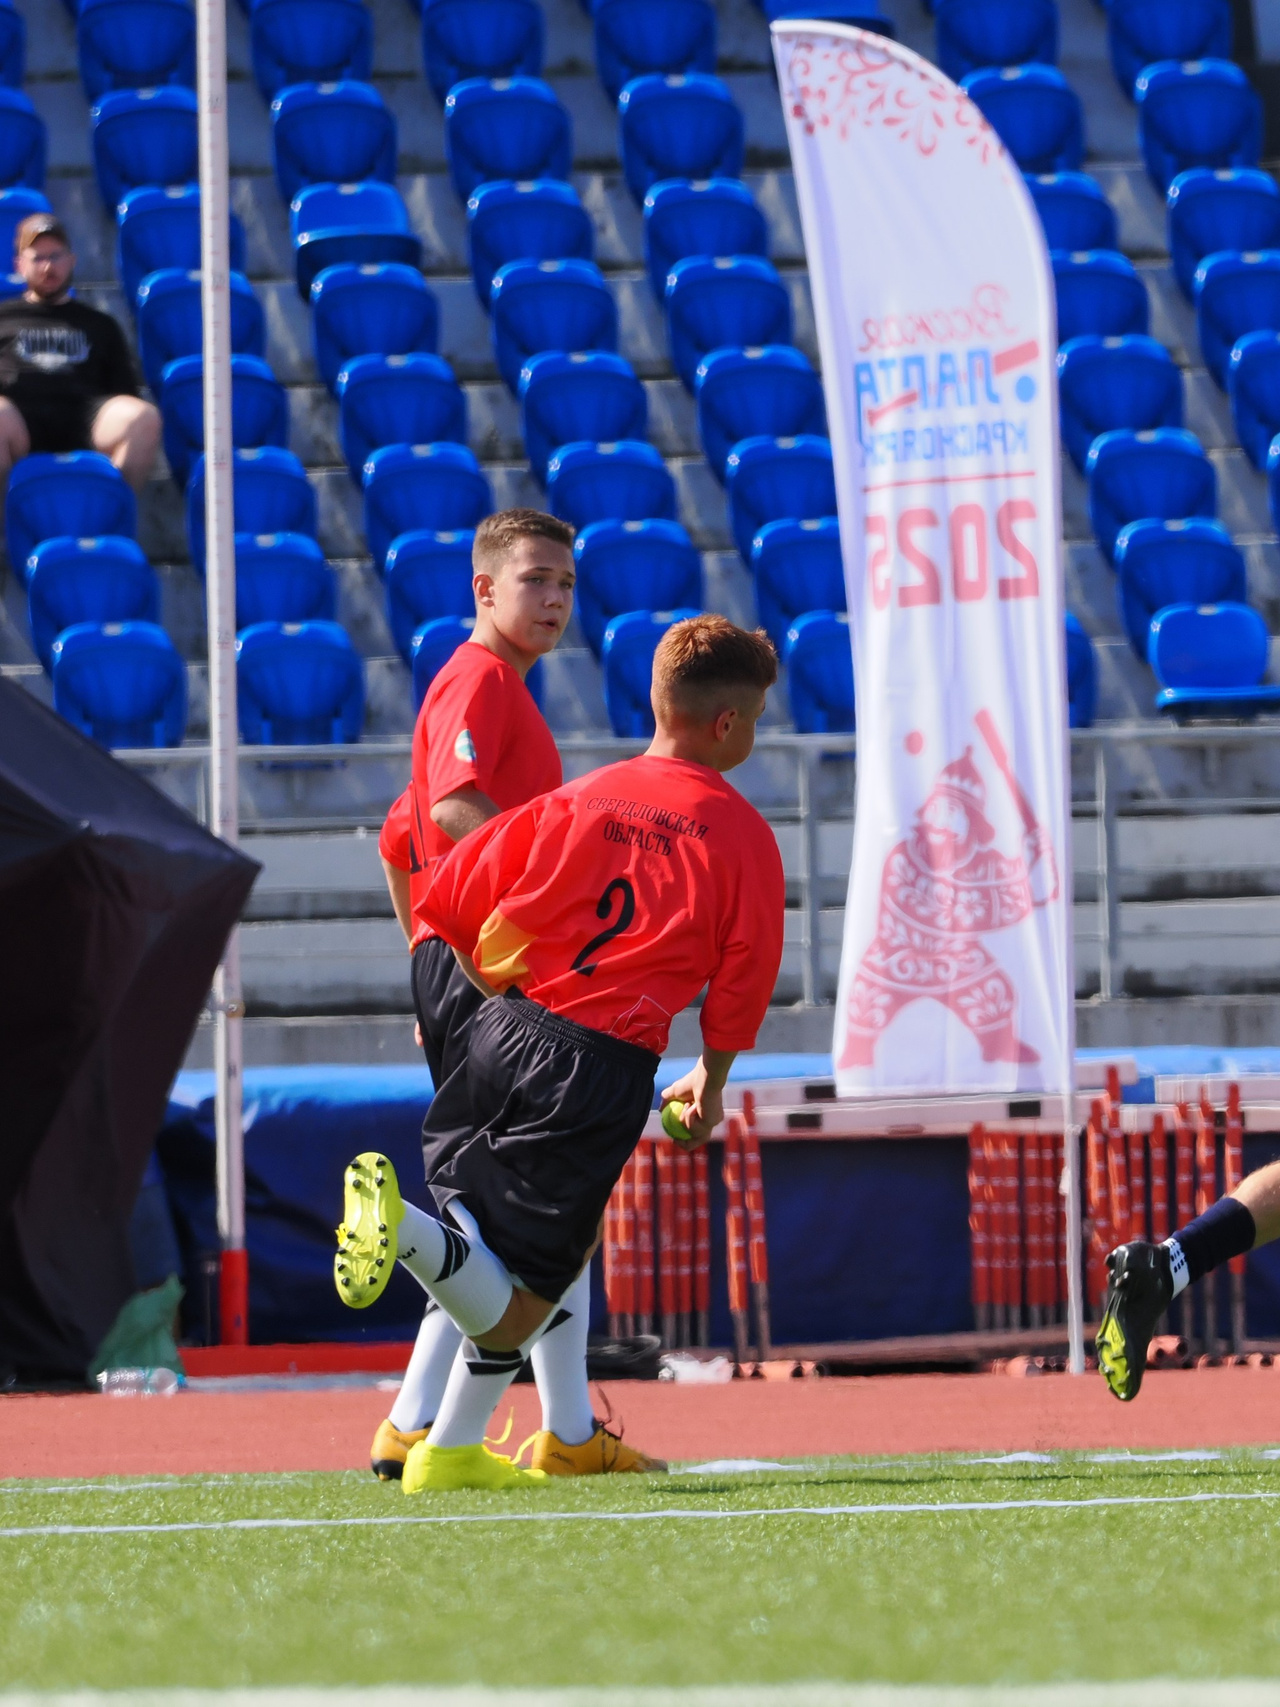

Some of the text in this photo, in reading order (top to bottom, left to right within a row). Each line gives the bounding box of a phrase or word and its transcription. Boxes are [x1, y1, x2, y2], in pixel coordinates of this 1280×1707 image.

[586, 797, 709, 841] СВЕРДЛОВСКАЯ
[603, 820, 672, 857] ОБЛАСТЬ
[569, 877, 636, 978] 2
